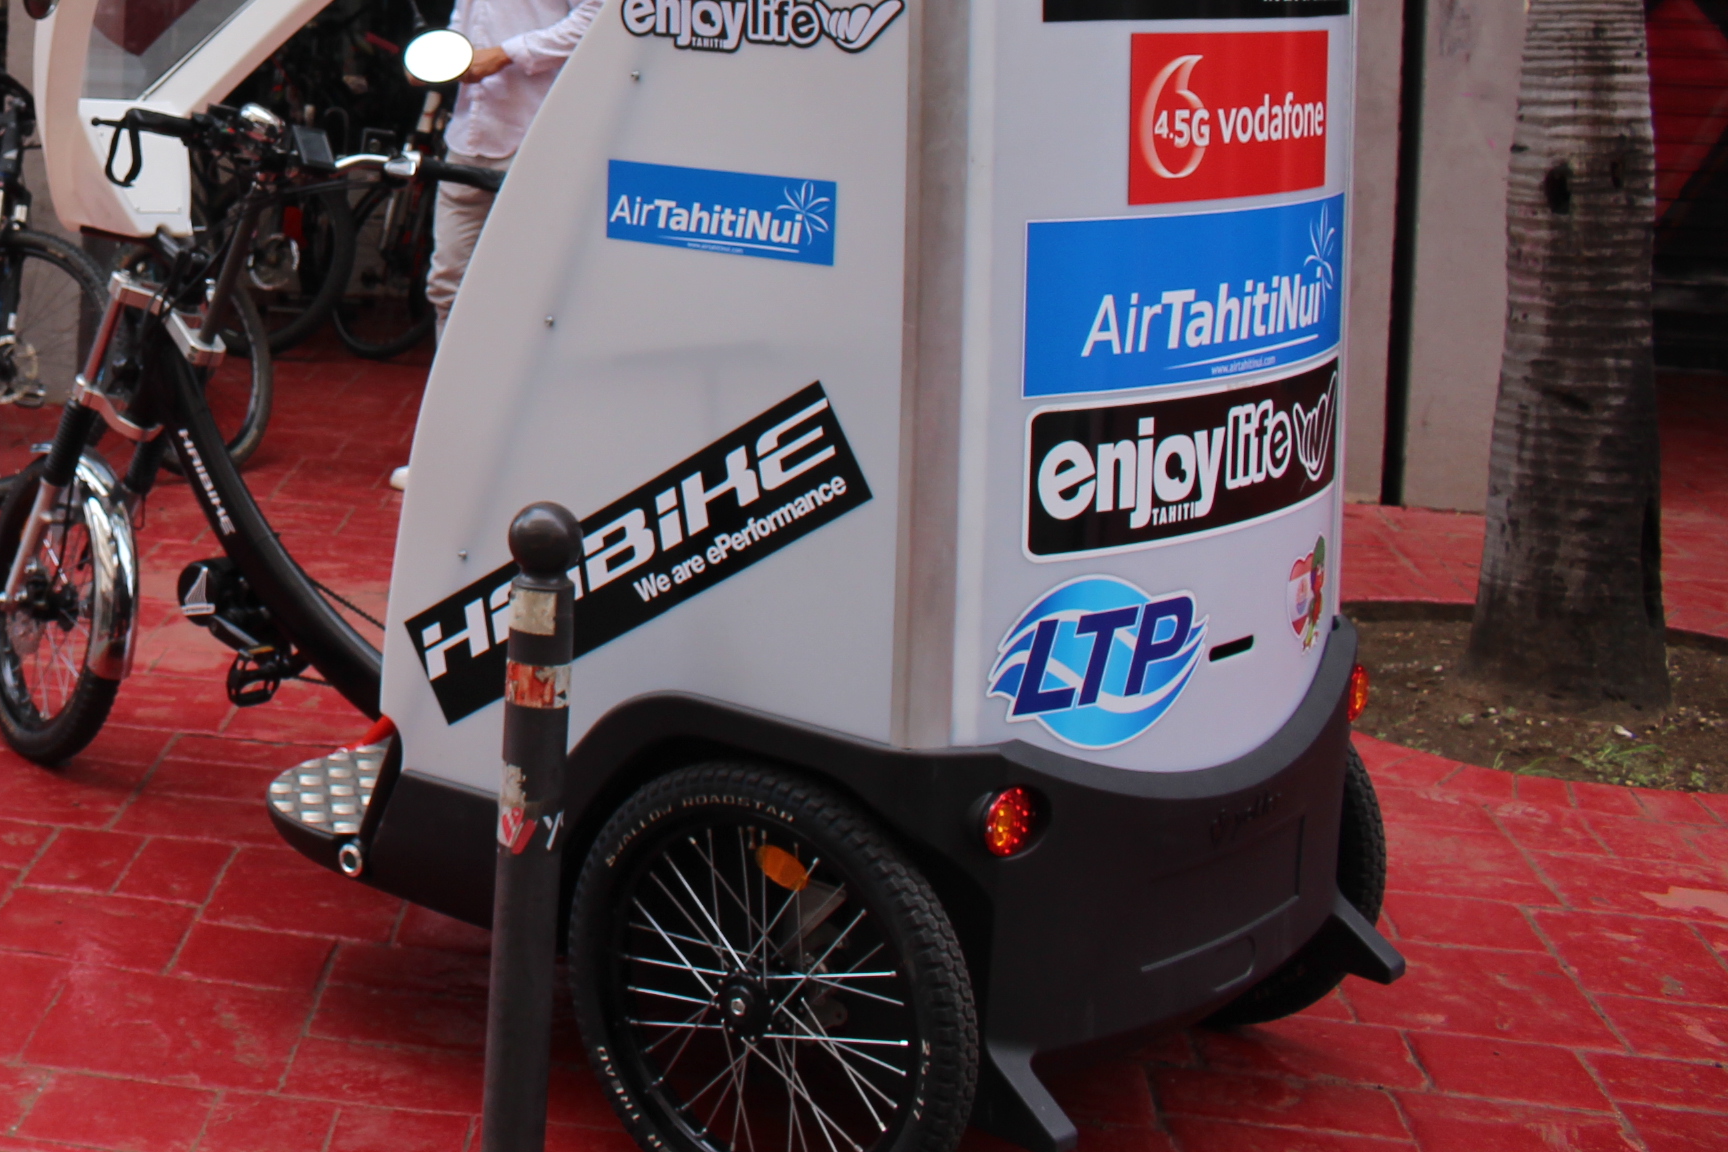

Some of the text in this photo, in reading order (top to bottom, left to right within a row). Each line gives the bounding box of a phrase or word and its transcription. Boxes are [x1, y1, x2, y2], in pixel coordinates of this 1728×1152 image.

[1153, 93, 1325, 147] 4.5G vodafone
[609, 192, 806, 247] AirTahitiNui
[1080, 266, 1323, 358] AirTahitiNui
[1037, 398, 1292, 530] enjoylife
[632, 473, 849, 604] We are ePerformance
[1150, 500, 1197, 528] TAHITI
[1011, 595, 1194, 717] LTP
